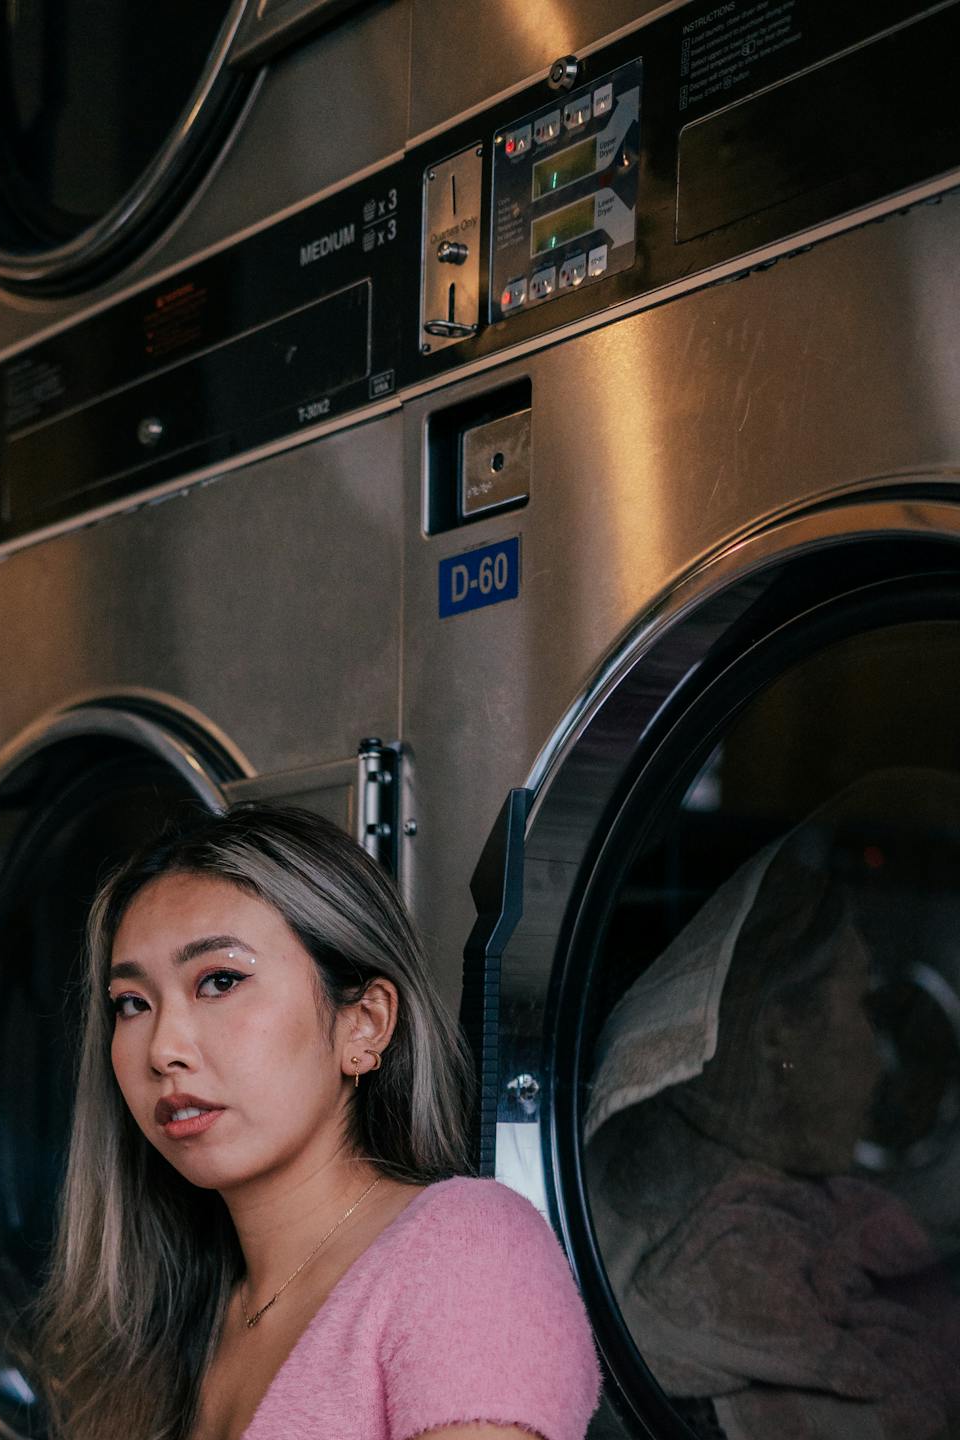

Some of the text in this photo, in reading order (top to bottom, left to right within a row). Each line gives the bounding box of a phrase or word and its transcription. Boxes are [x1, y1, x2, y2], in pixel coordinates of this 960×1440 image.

[682, 1, 736, 35] INSTRUCTIONS
[387, 188, 398, 210] 3
[300, 223, 356, 267] MEDIUM
[386, 218, 397, 241] 3
[450, 551, 509, 604] D-60
